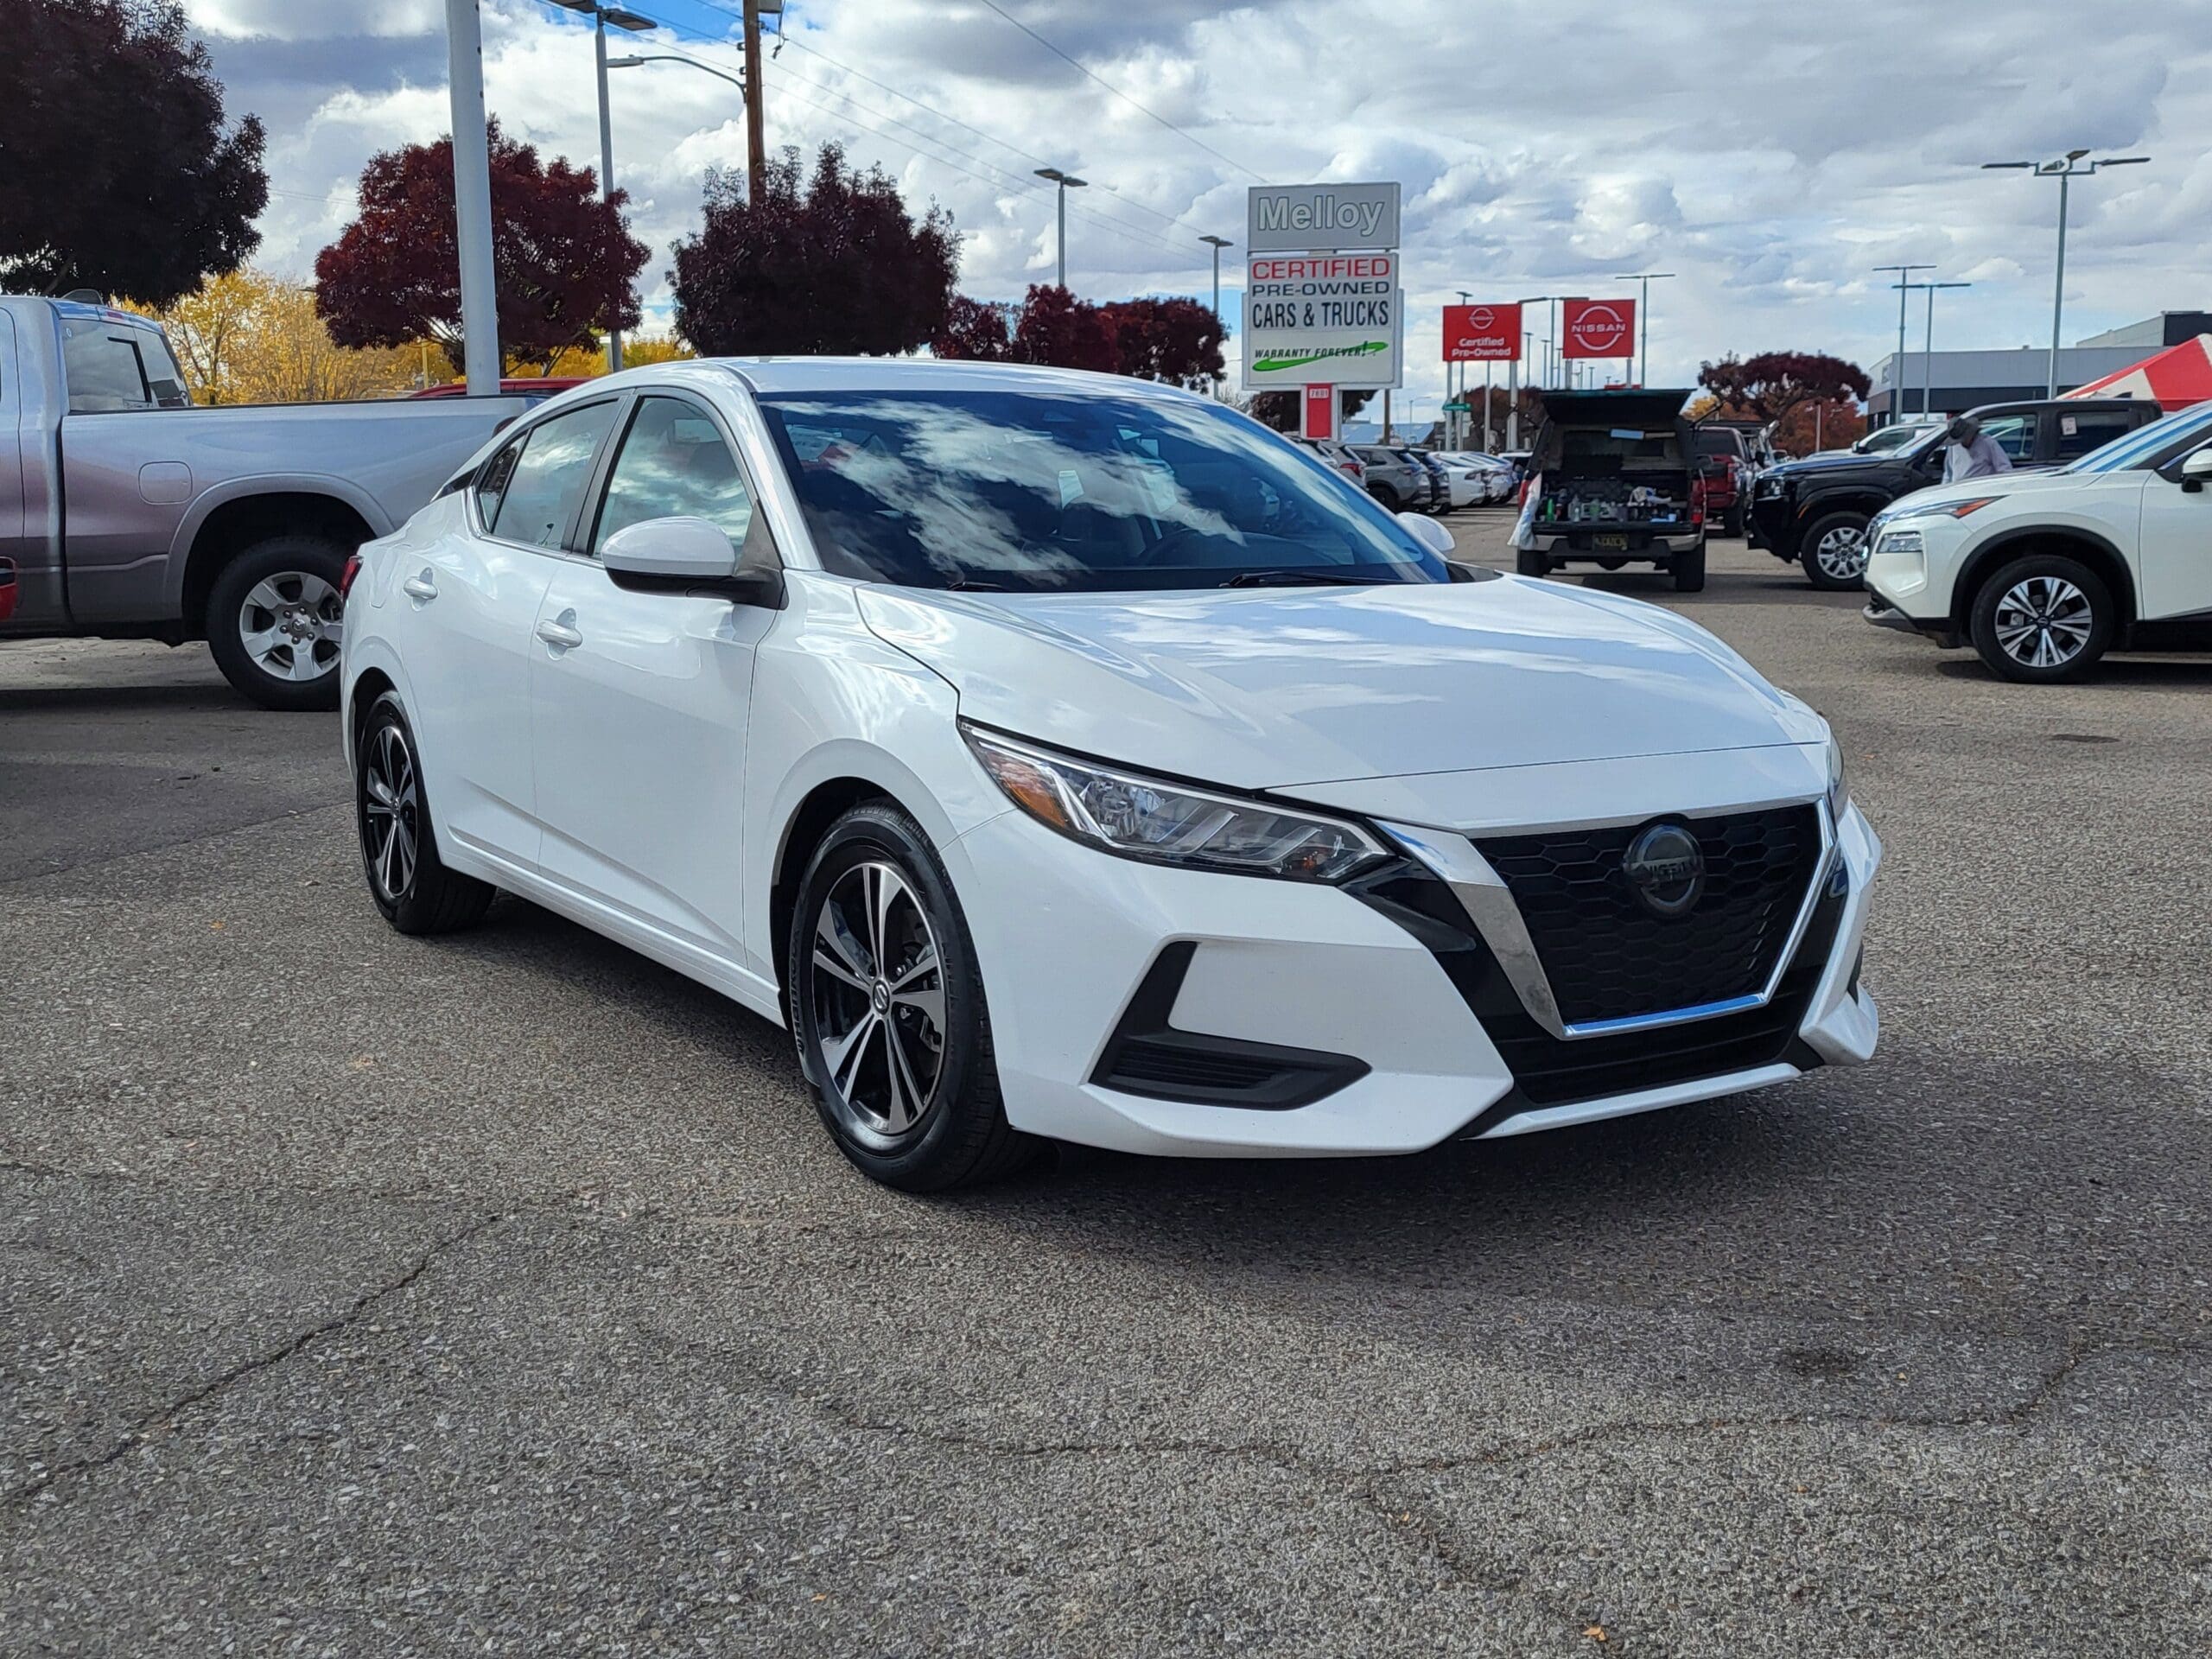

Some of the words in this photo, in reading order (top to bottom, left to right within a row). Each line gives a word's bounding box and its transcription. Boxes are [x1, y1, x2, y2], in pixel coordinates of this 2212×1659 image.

[1257, 194, 1385, 237] Melloy
[1252, 258, 1390, 280] CERTIFIED
[1252, 281, 1390, 297] PRE-OWNED
[1253, 302, 1297, 328] CARS
[1303, 302, 1315, 327] &
[1321, 300, 1389, 327] TRUCKS
[1571, 323, 1626, 333] NISSAN
[1459, 337, 1505, 347] Certified
[1255, 348, 1311, 359] WARRANTY
[1452, 346, 1512, 357] Pre-Owned
